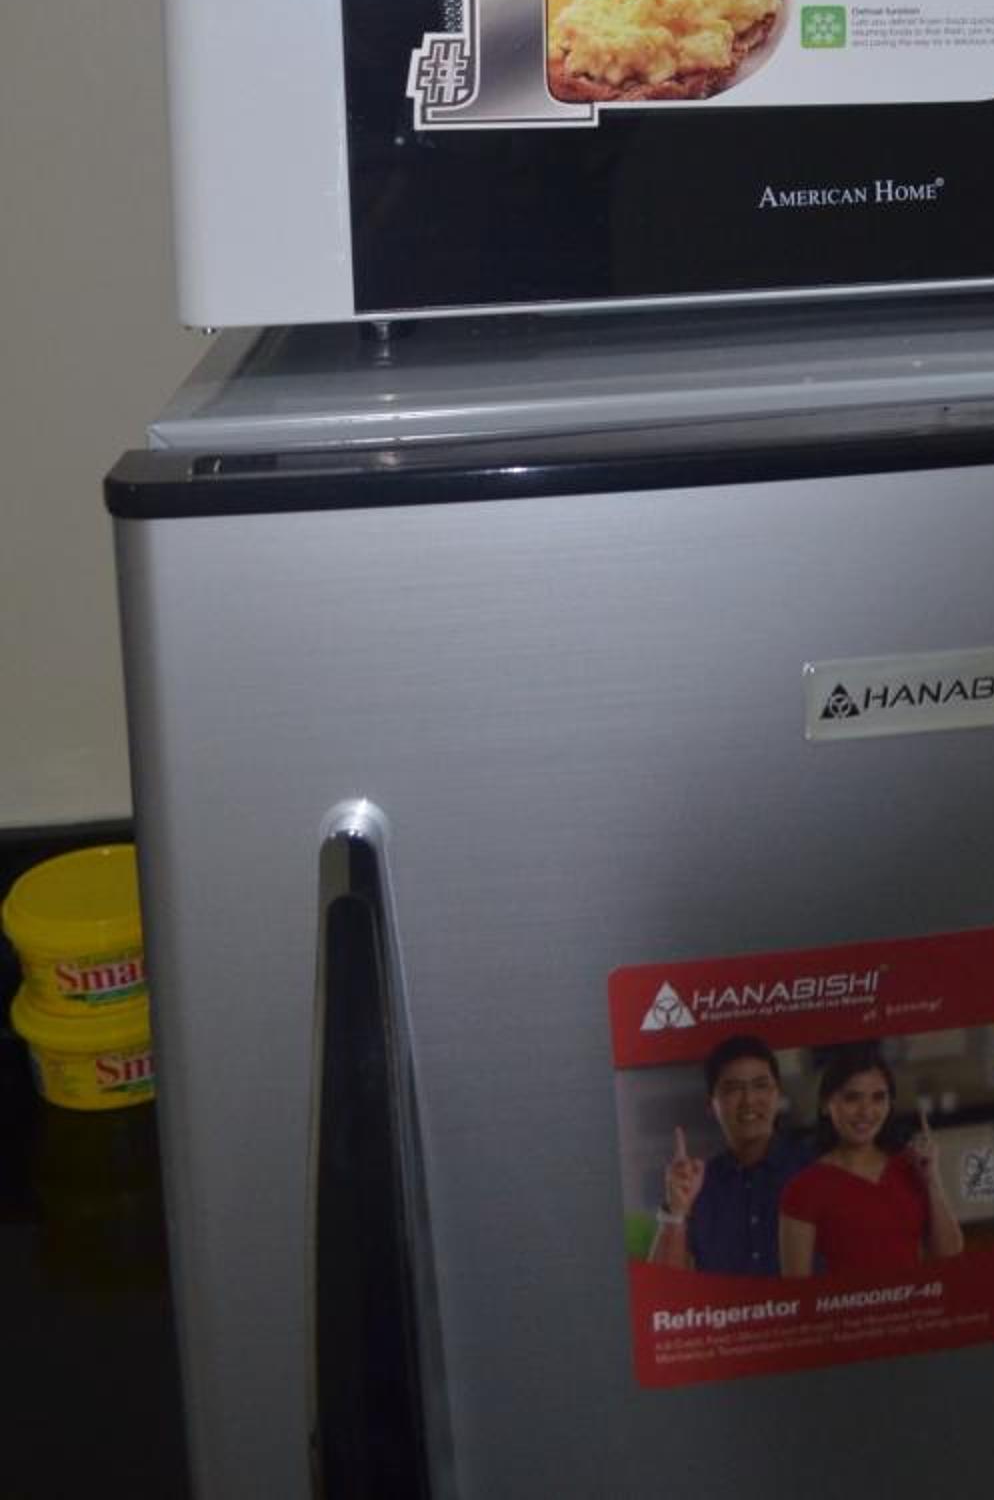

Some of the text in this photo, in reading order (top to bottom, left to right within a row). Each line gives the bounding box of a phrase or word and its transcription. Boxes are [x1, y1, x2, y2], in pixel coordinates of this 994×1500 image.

[757, 185, 868, 209] AMERICAN
[692, 969, 880, 1011] HANABISHI
[653, 1298, 800, 1333] Refrigerator
